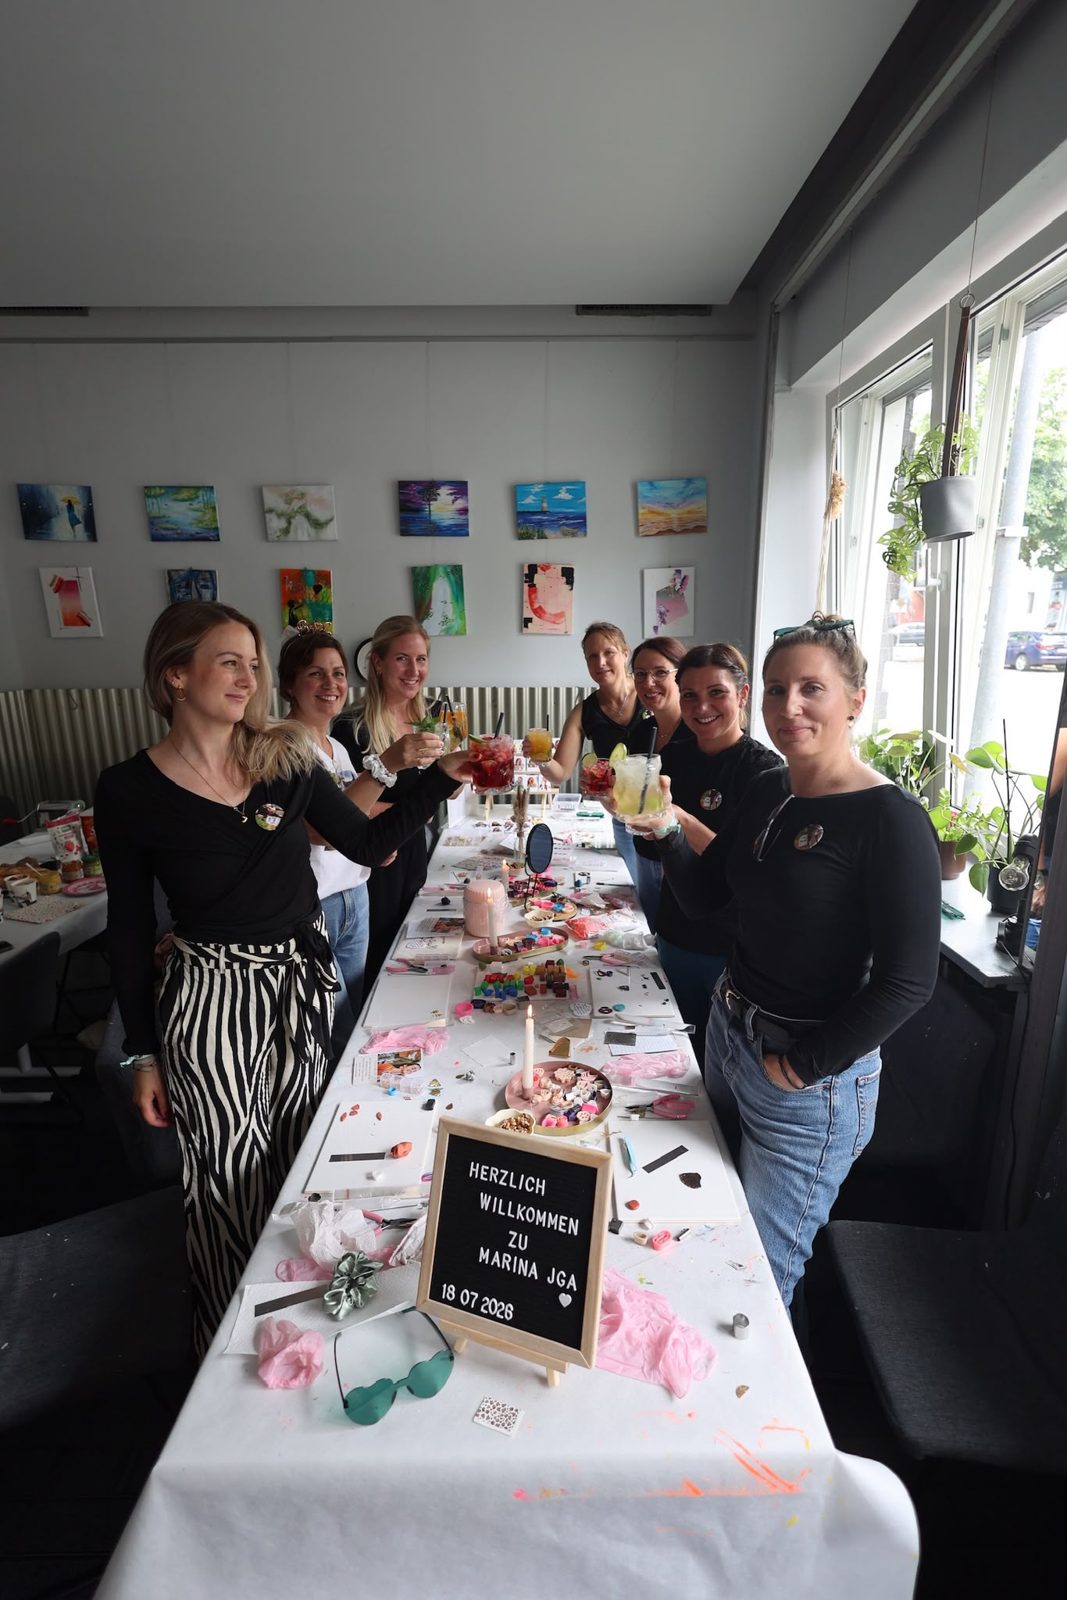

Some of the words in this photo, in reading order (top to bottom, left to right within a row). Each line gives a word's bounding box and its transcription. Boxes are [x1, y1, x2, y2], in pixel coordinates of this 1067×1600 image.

[469, 1161, 546, 1197] HERZLICH
[479, 1191, 579, 1236] WILLKOMMEN
[508, 1230, 529, 1251] ZU
[478, 1246, 539, 1280] MARINA
[546, 1267, 577, 1292] JGA
[441, 1283, 456, 1302] 18
[459, 1288, 479, 1309] 07
[480, 1296, 514, 1321] 2026
